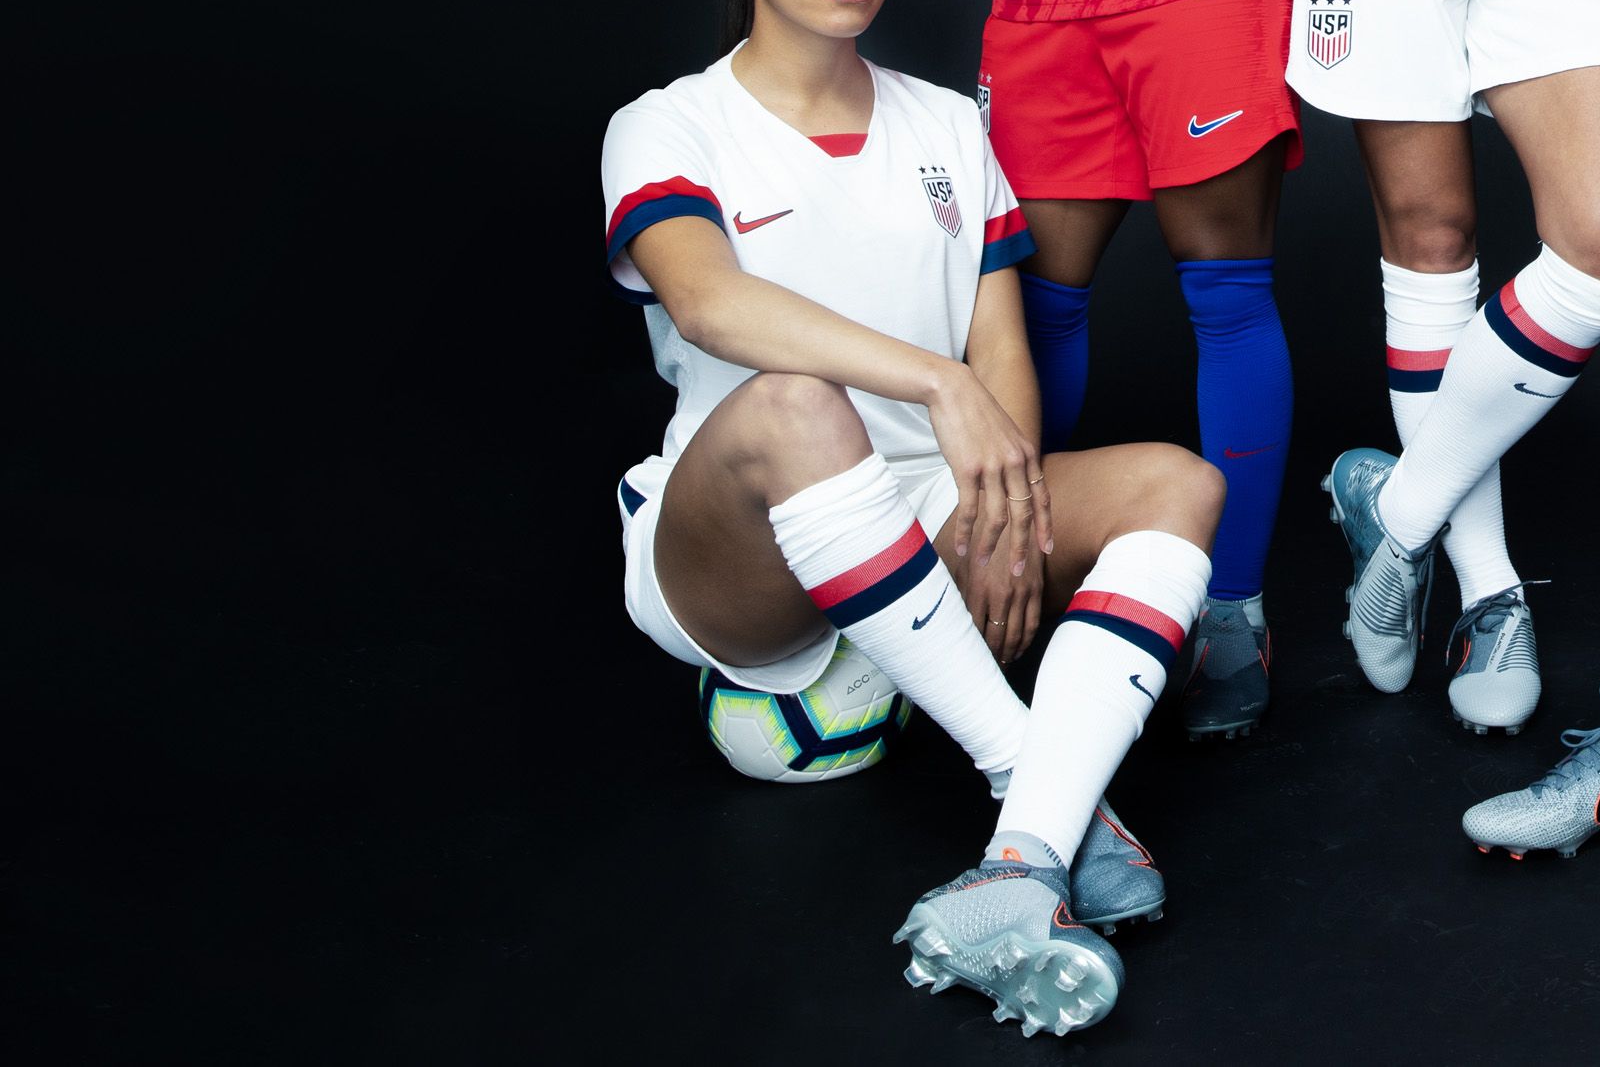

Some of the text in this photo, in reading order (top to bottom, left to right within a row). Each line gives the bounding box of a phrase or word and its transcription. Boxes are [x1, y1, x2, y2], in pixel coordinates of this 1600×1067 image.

[1312, 13, 1348, 35] USA
[978, 88, 989, 109] SA
[927, 181, 953, 203] USA
